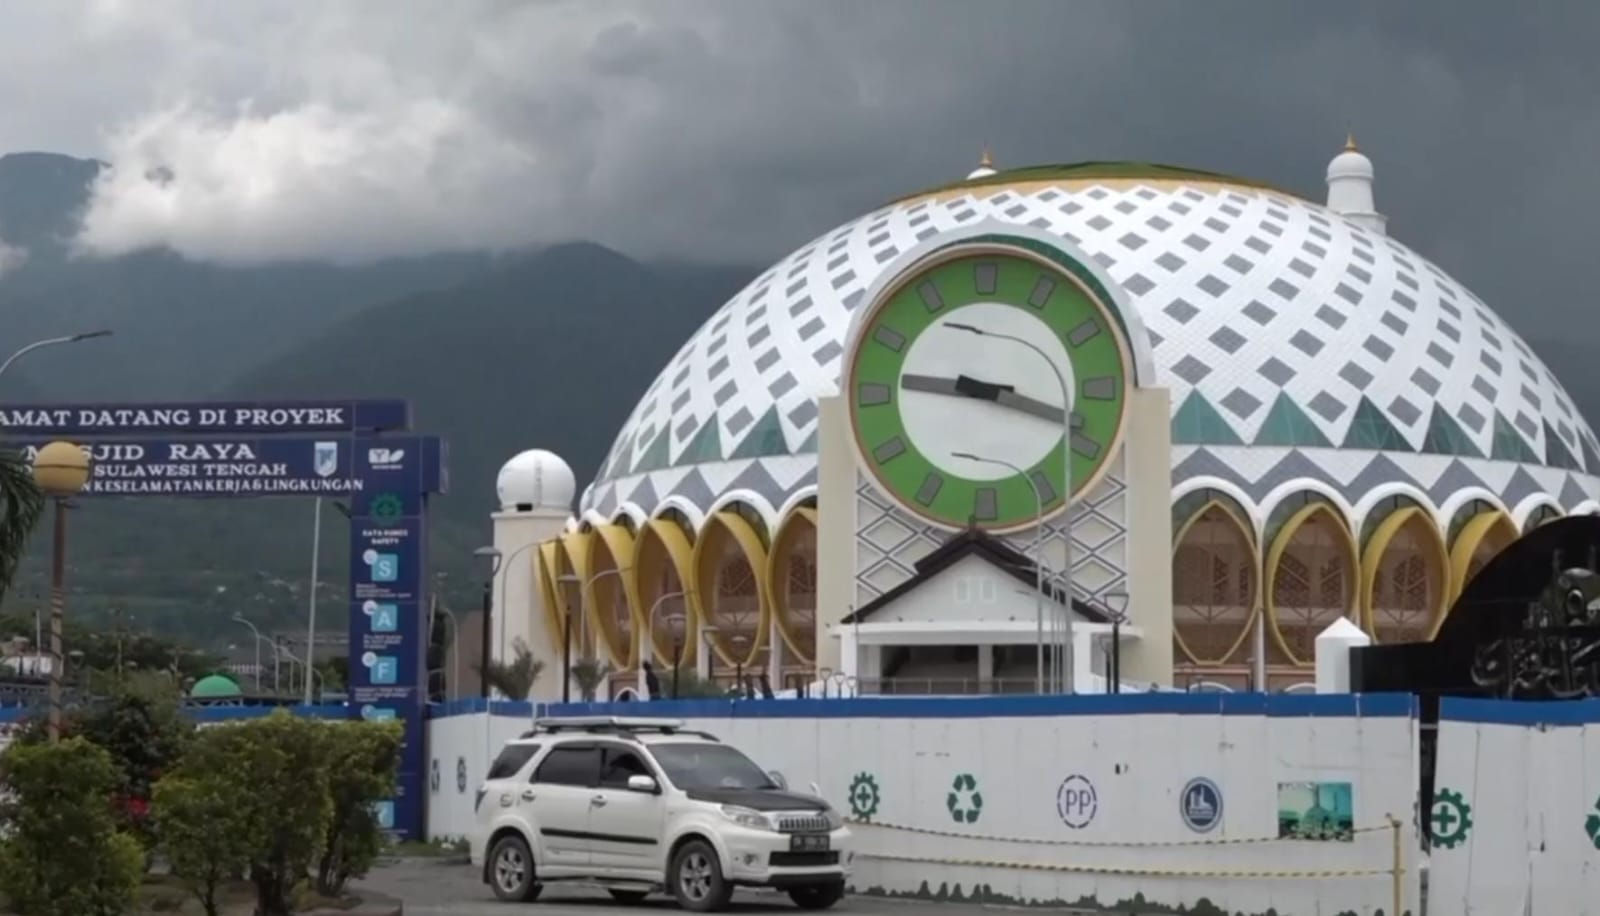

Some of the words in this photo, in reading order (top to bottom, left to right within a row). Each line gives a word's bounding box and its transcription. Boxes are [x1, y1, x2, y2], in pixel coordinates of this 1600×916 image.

[79, 409, 191, 426] DATANG
[199, 409, 227, 425] DI
[235, 408, 345, 425] PROYEK
[169, 443, 256, 460] RAYA
[94, 463, 197, 477] SULAWESI
[203, 463, 288, 477] TENGAH
[378, 560, 391, 578] S
[377, 611, 393, 627] A
[377, 662, 389, 680] F
[1066, 788, 1091, 815] PP
